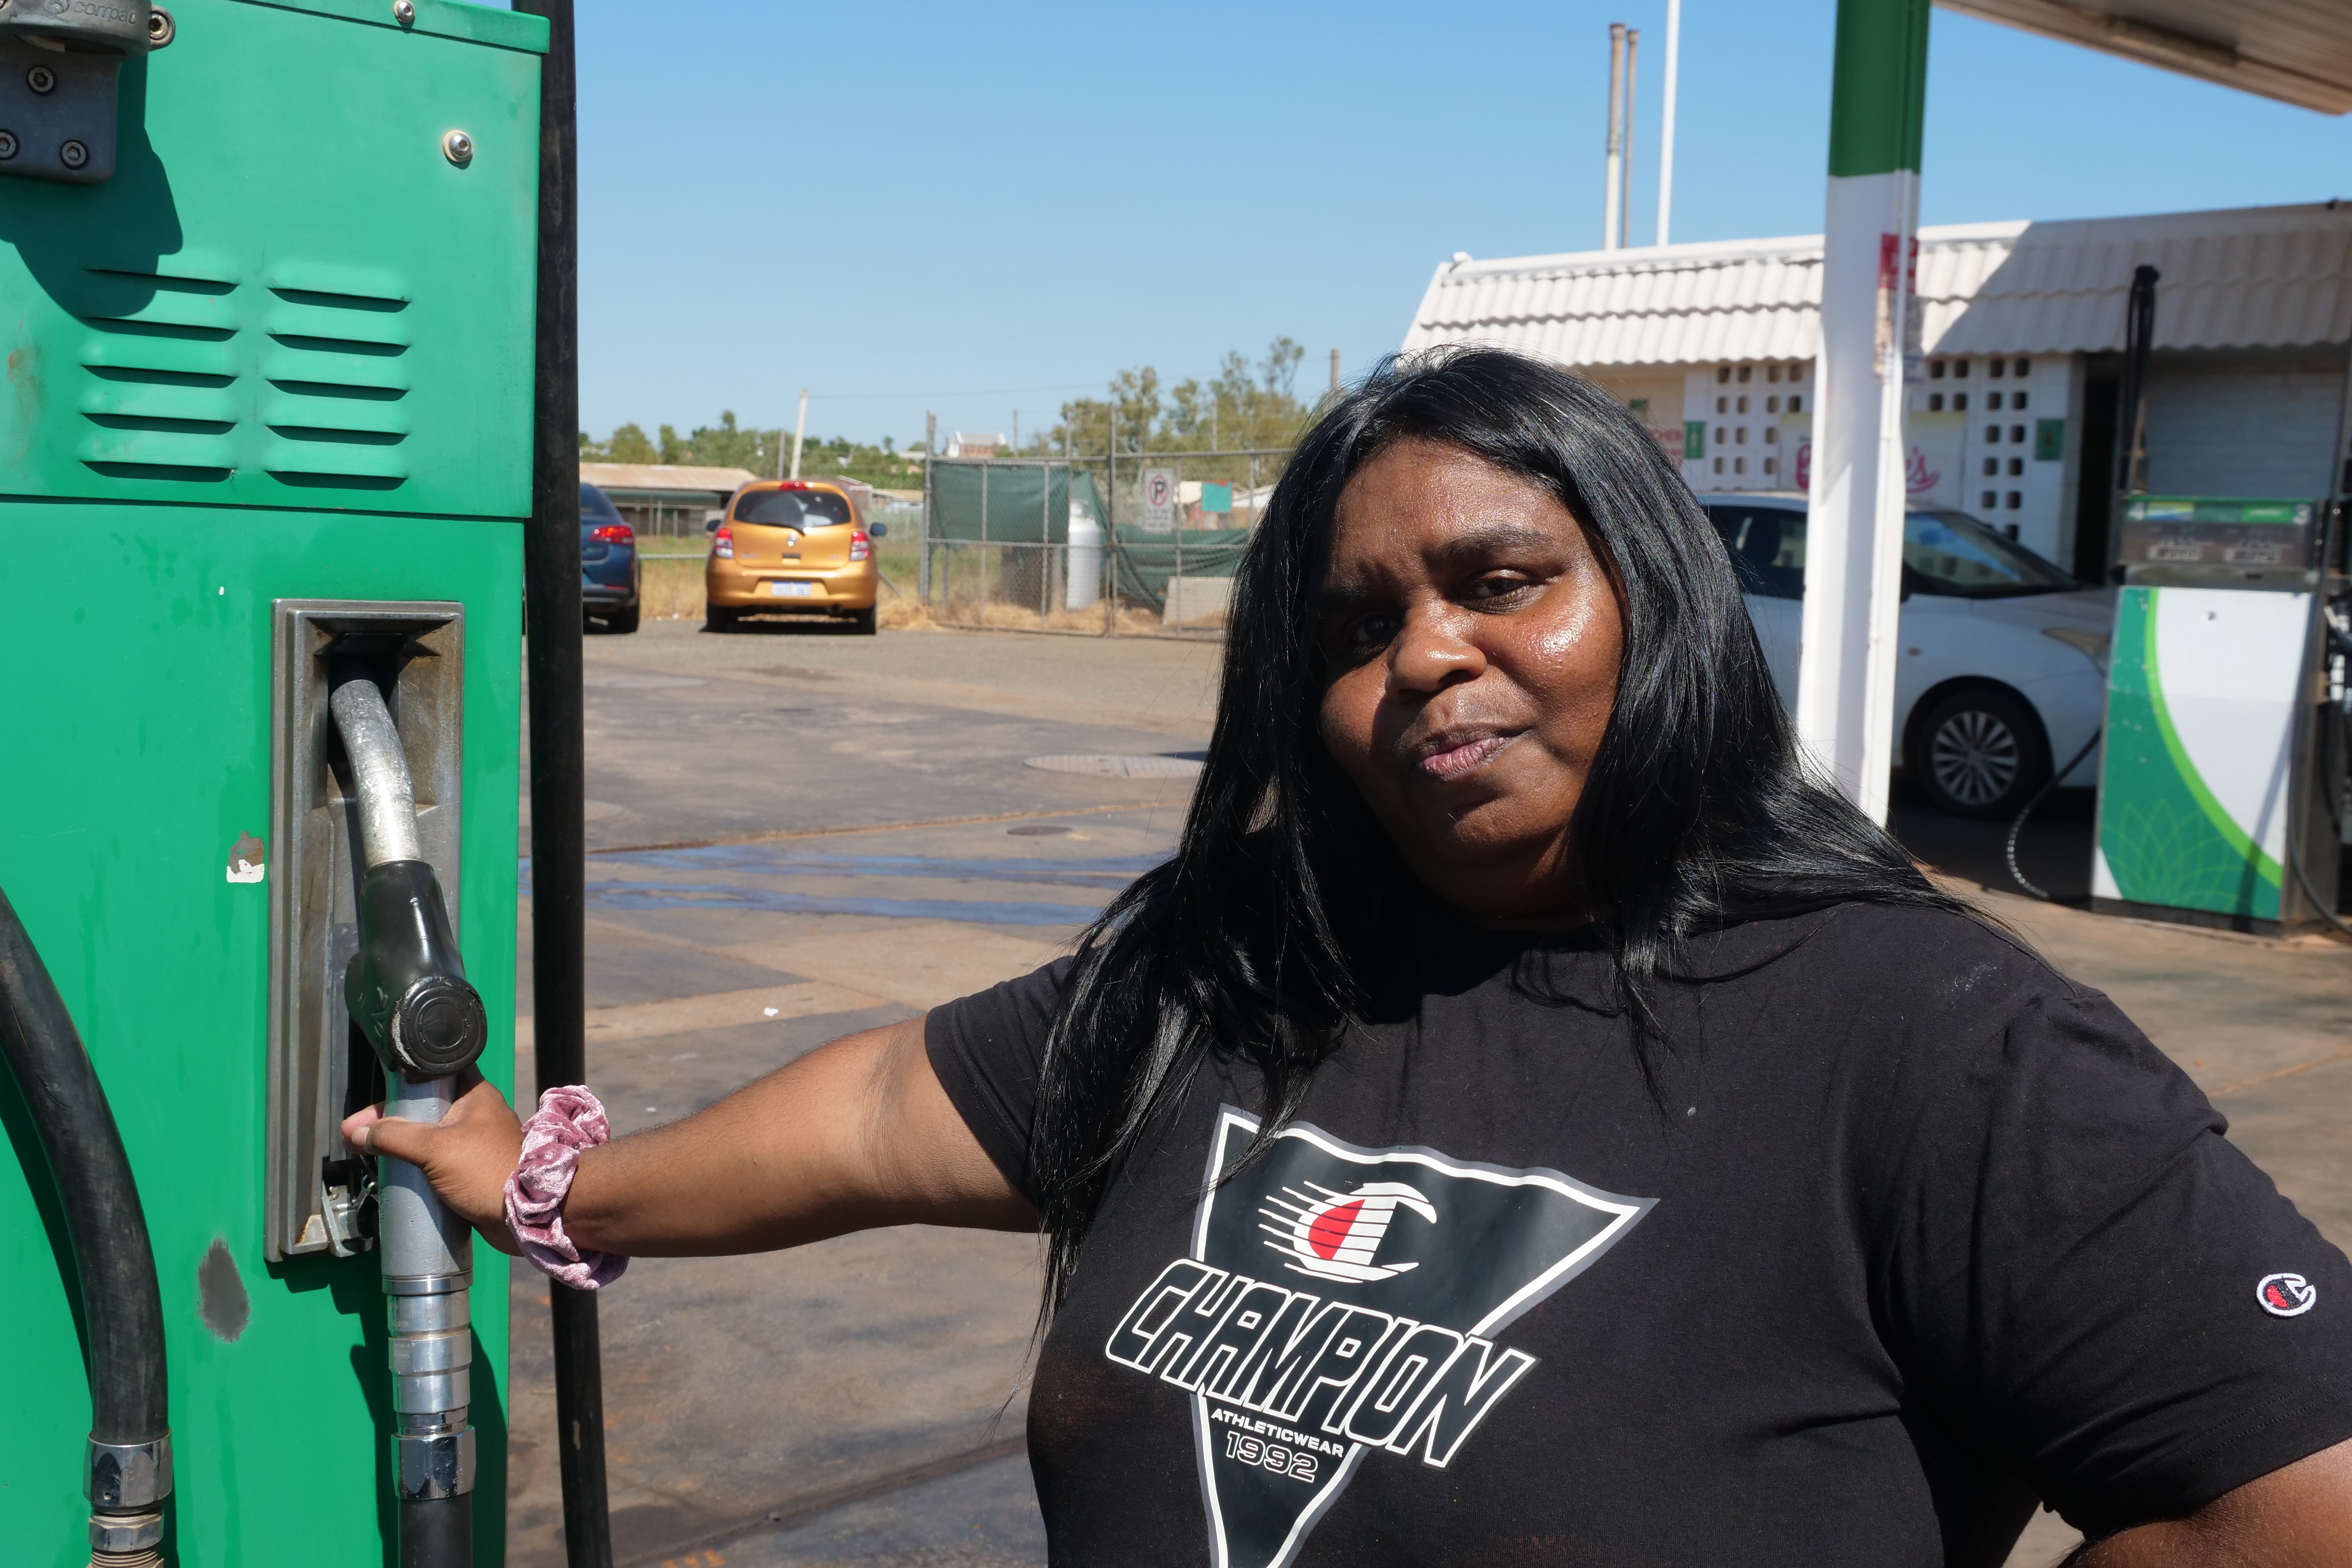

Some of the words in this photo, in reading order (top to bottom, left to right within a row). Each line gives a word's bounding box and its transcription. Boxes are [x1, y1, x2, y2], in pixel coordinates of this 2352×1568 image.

[1105, 1258, 1537, 1468] CHAMPION
[1211, 1408, 1344, 1457] ATHLETICWEAR
[1226, 1430, 1318, 1483] 1992
